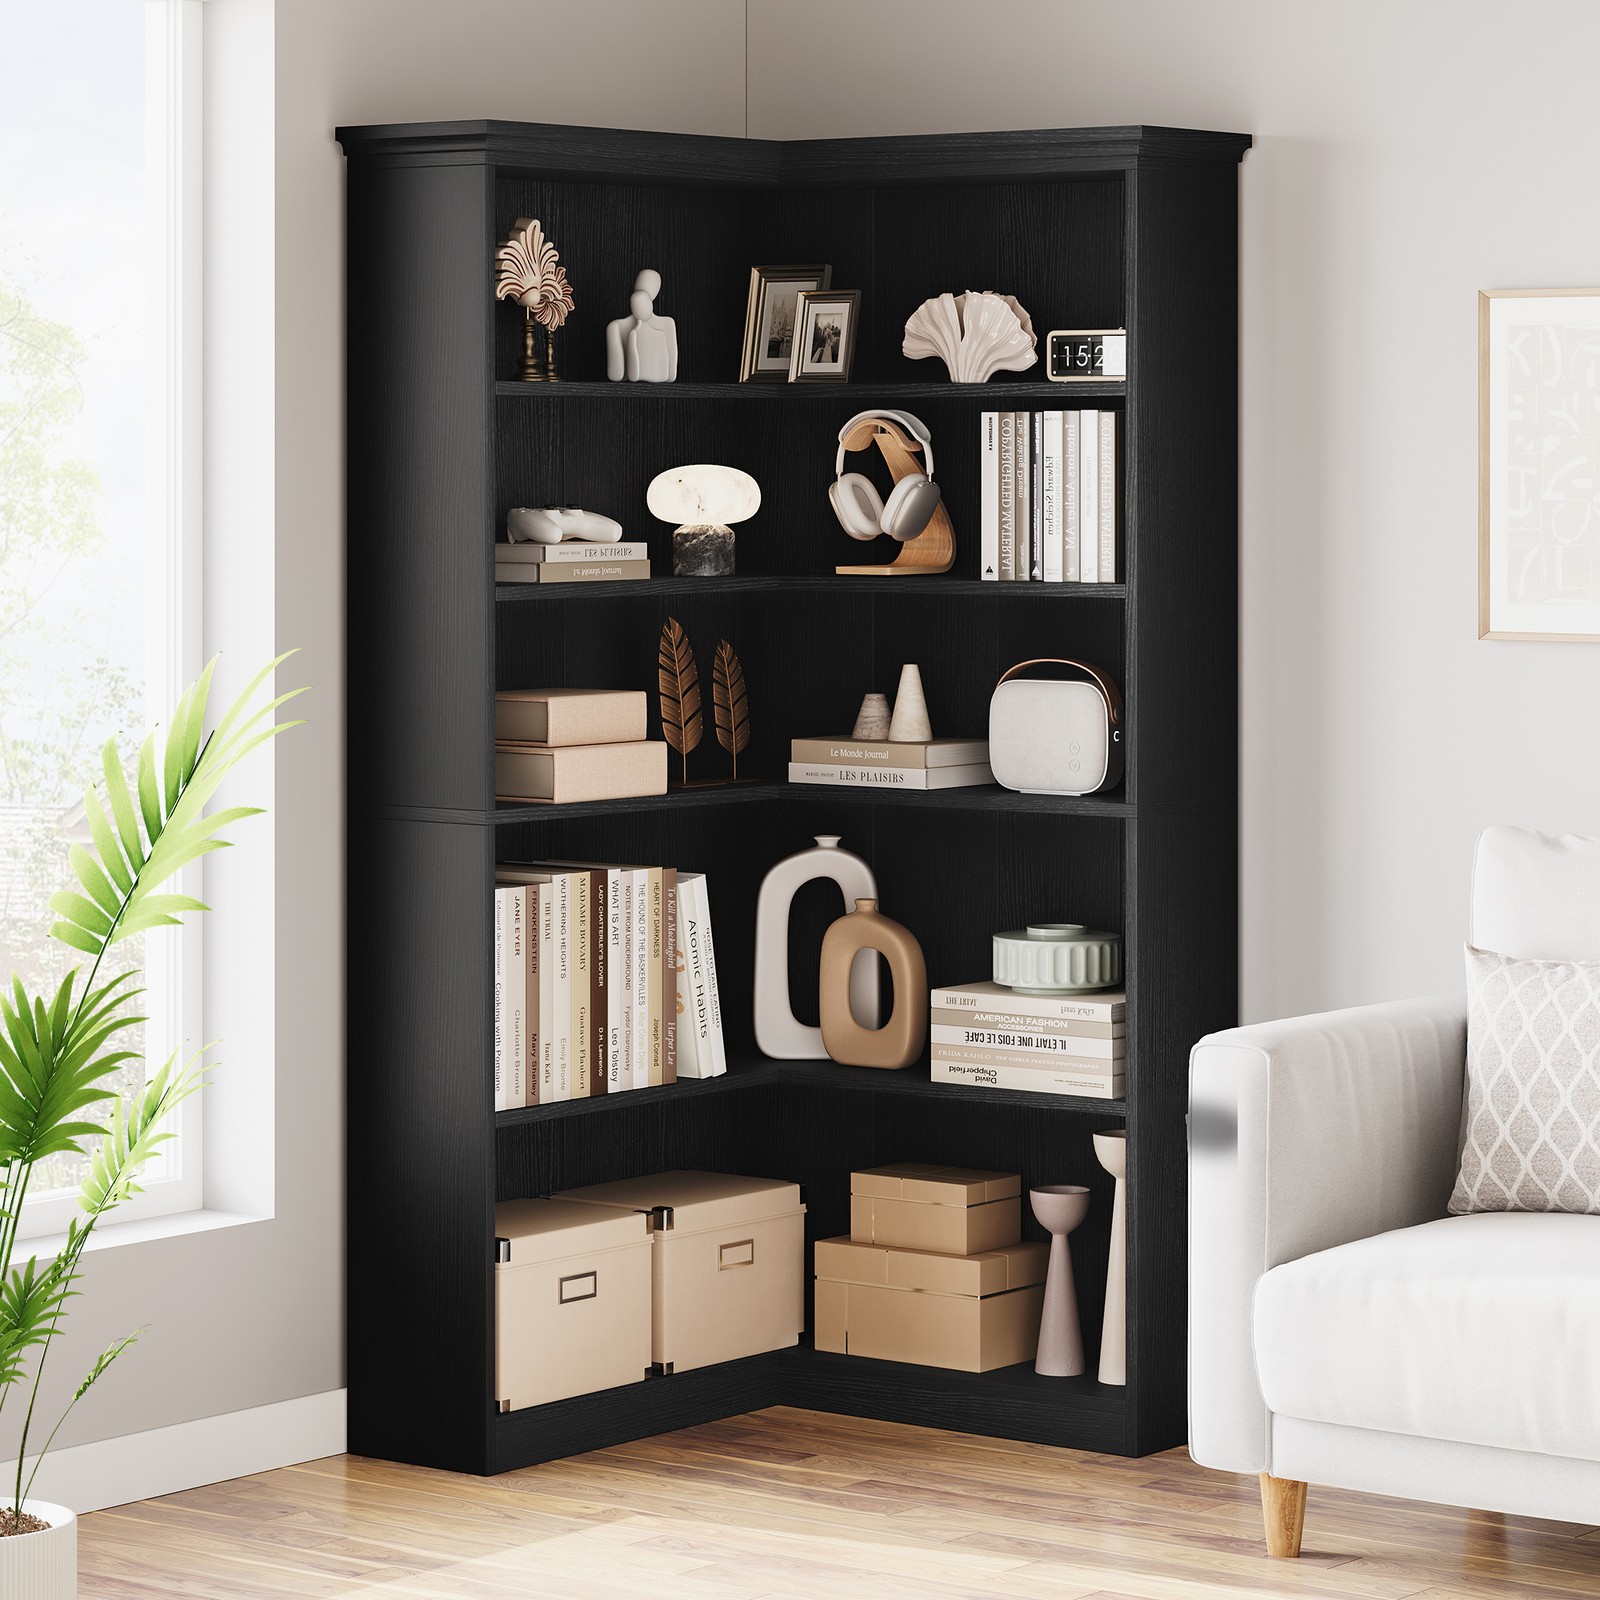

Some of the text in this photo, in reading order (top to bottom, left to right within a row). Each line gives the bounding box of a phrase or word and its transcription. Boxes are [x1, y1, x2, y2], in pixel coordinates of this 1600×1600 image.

[831, 748, 889, 759] Le Monde Journal
[839, 771, 904, 783] LES PLAISIRS
[667, 887, 675, 898] To
[667, 900, 675, 914] Kill
[612, 914, 619, 923] IS
[654, 909, 660, 918] OF
[497, 933, 502, 941] de
[639, 927, 645, 937] OF
[666, 923, 675, 969] Mockingbird
[709, 957, 714, 969] TO
[688, 920, 708, 1039] Atomic Habits
[974, 1014, 1068, 1028] AMERICAN FASHION
[998, 1024, 1043, 1032] ACCESSORIES
[666, 1022, 675, 1065] Harper Lee
[965, 1031, 1067, 1051] IL ÉTAIT UNE FOIS LE CAFÉ
[938, 1050, 991, 1060] FRIDA KAHLO
[610, 1050, 619, 1082] Tolstoy
[949, 1066, 997, 1077] Chipperfield
[975, 1076, 997, 1084] David
